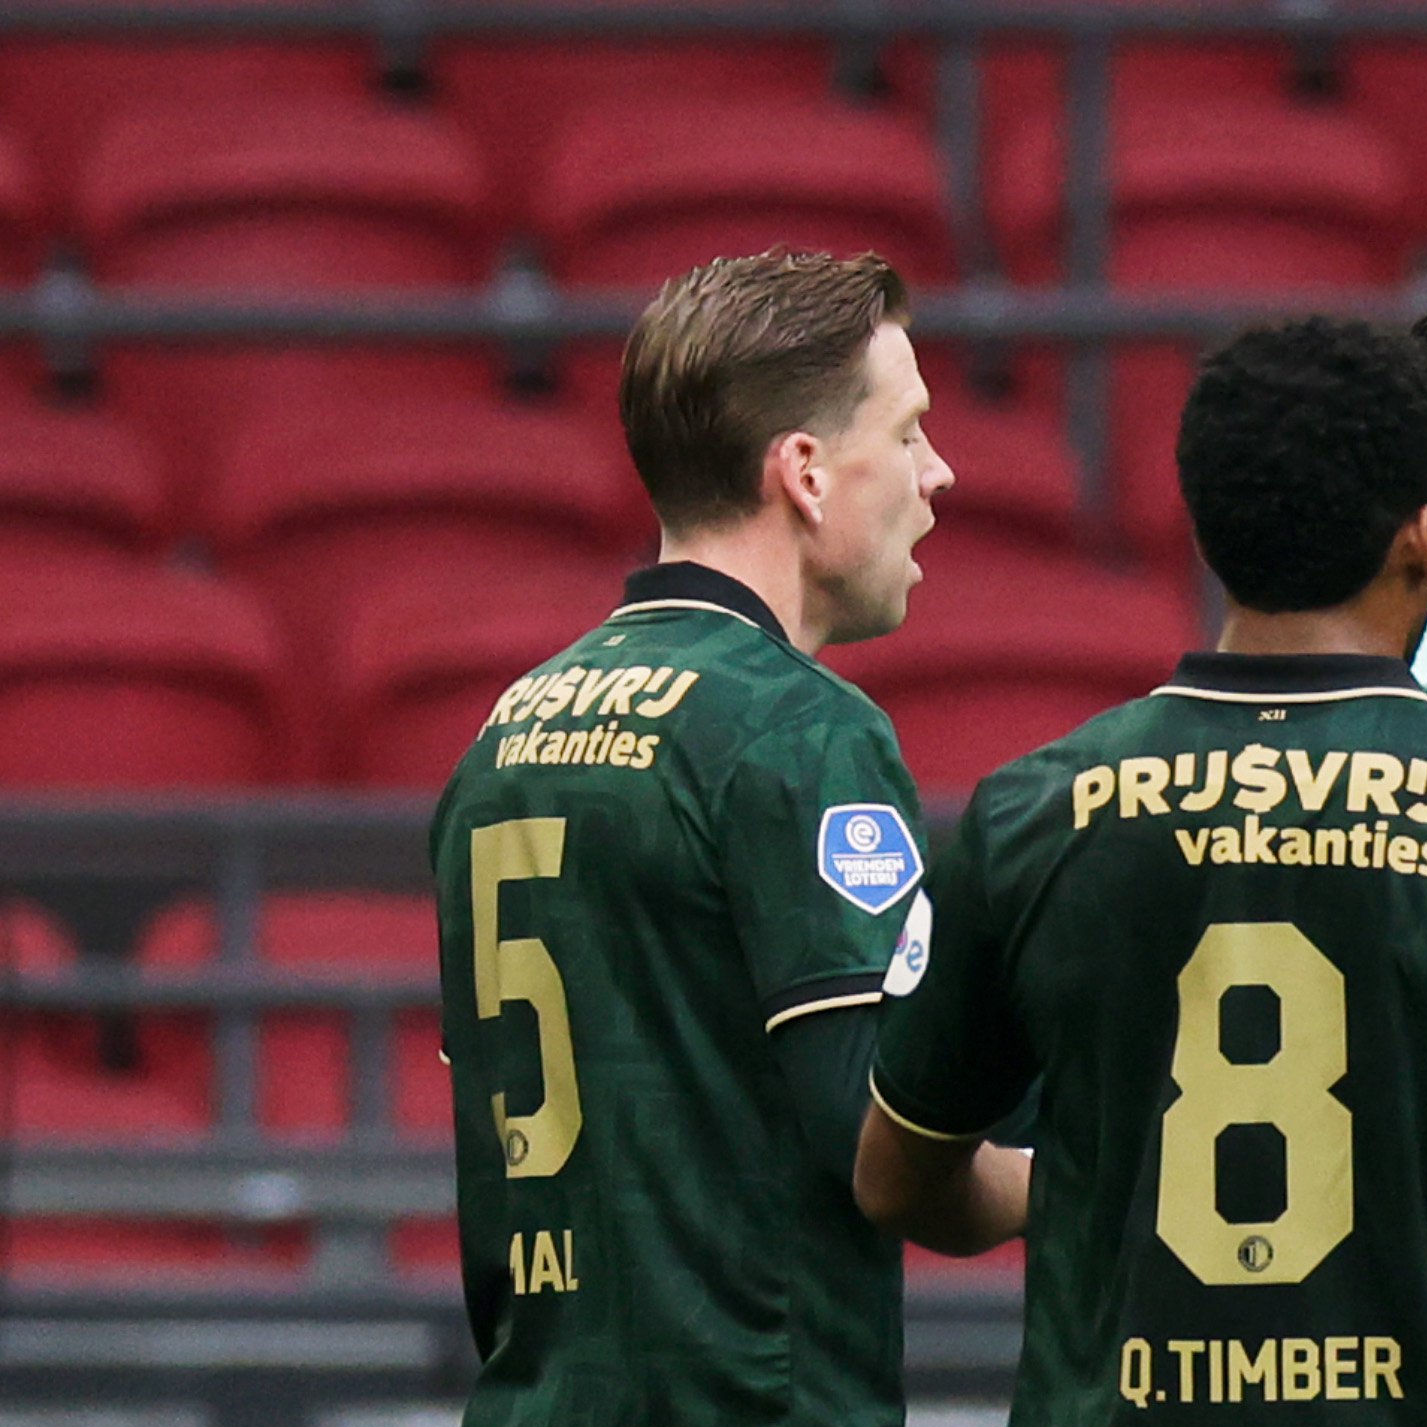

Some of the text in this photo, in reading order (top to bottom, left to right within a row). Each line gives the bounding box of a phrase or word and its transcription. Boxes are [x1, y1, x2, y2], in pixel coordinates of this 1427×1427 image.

[477, 665, 700, 741] RIJSVRIJ
[496, 719, 660, 770] vakanties
[833, 858, 905, 873] VRIENDEN
[844, 872, 897, 886] LOTERIJ
[470, 816, 583, 1179] 5
[1155, 922, 1355, 1286] 8
[1119, 1336, 1405, 1408] Q.TIMBER
